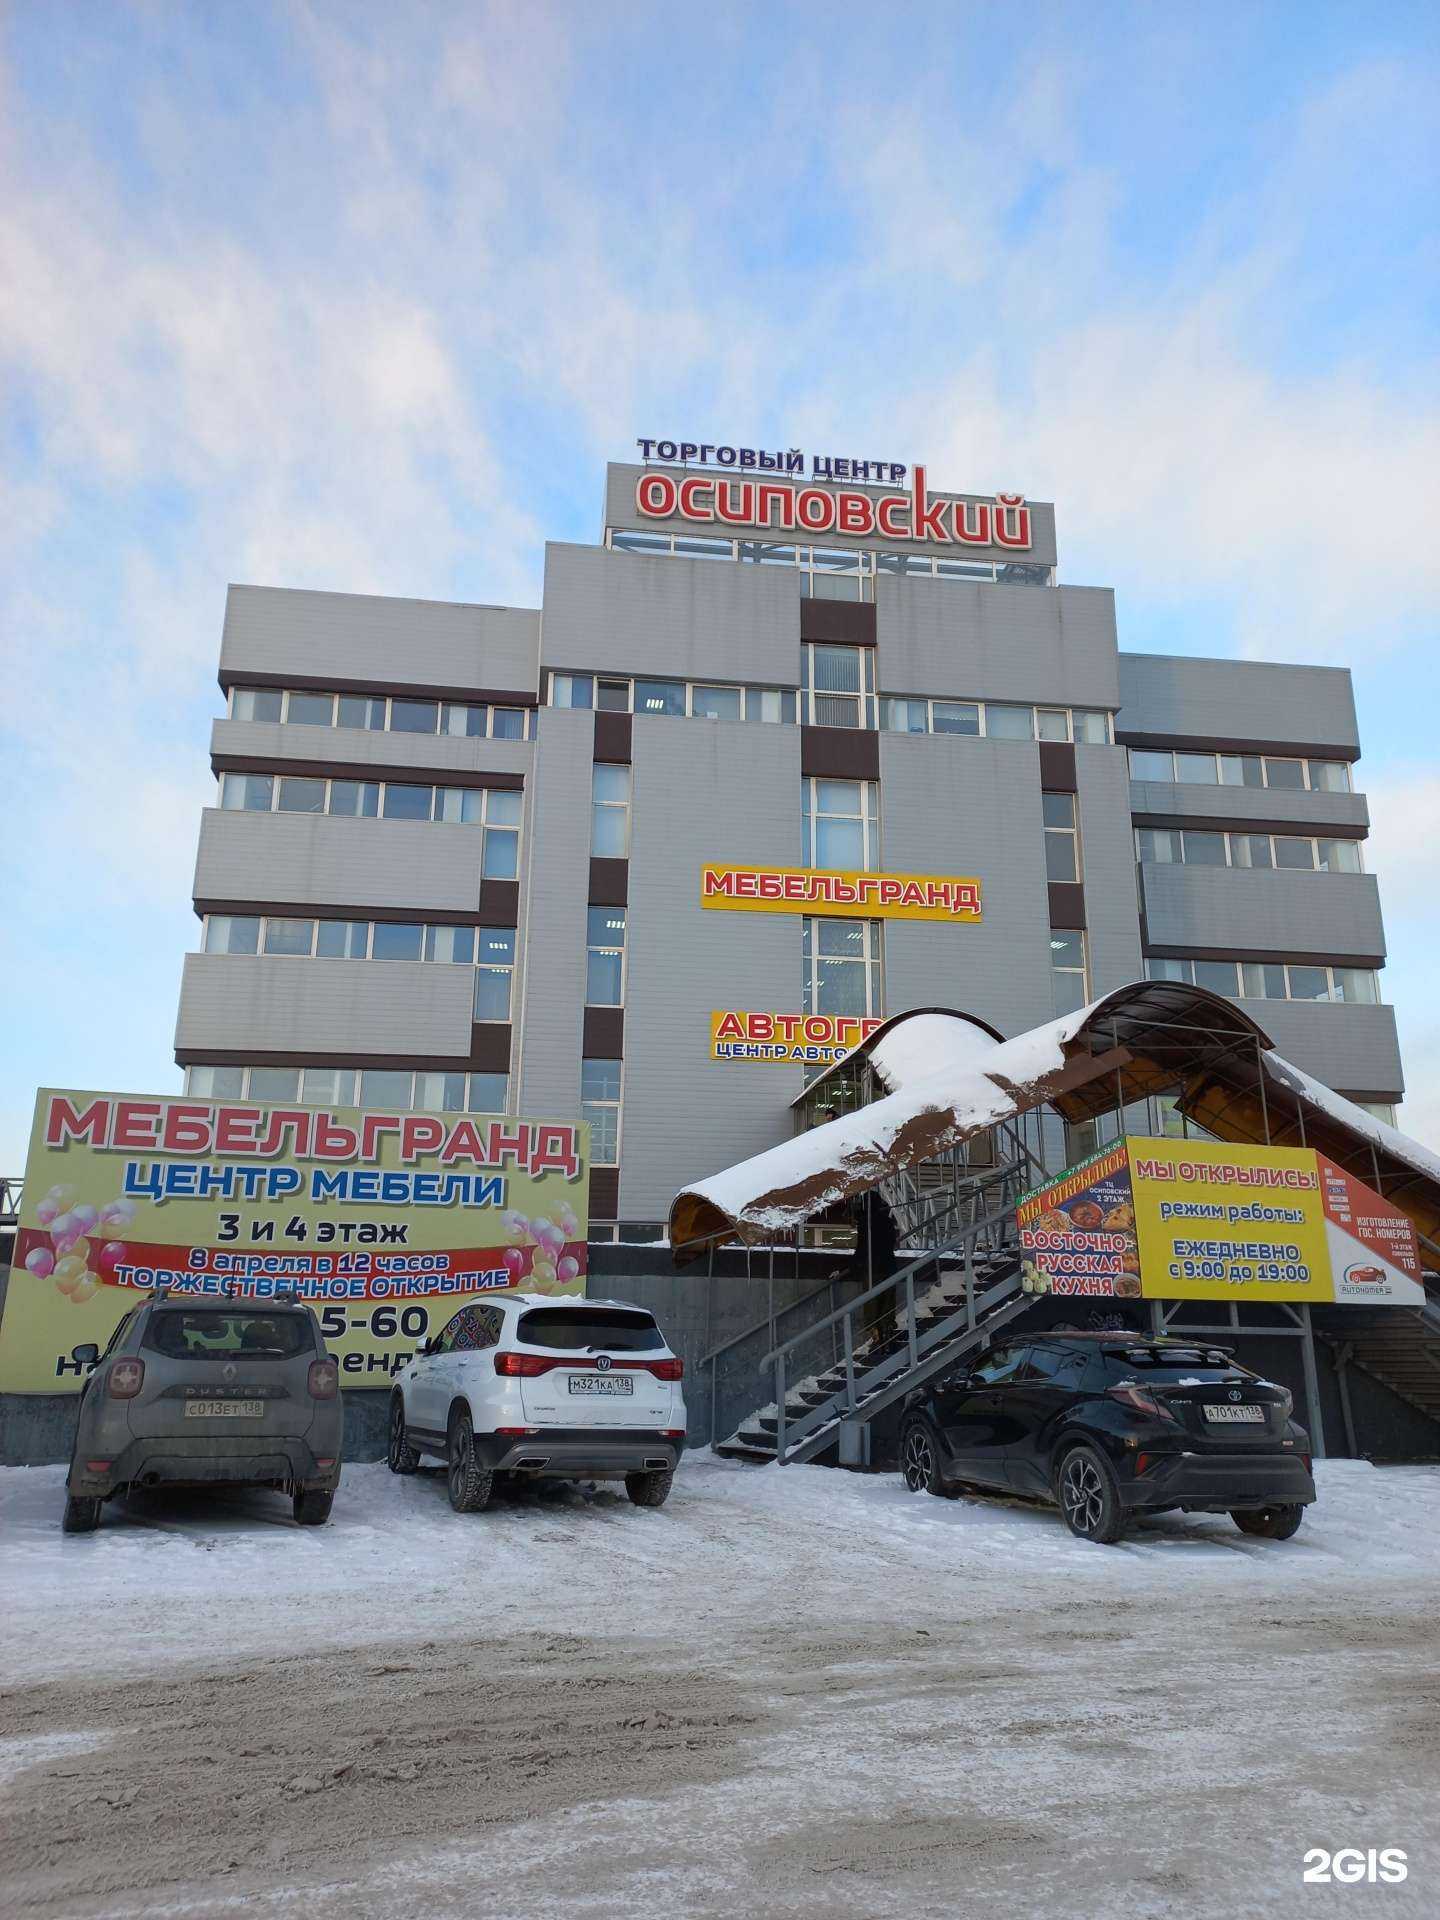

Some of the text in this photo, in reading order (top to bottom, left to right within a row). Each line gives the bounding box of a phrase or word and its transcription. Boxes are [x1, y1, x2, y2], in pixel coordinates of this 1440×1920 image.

[637, 438, 906, 481] ТОРГОВЫЙ ЦЕНТР
[704, 870, 981, 915] МЕБЕЛЬГРАНД
[715, 1013, 884, 1043] АВТОГР
[716, 1042, 852, 1061] ЦЕНТР АВТО
[45, 1096, 579, 1178] МЕБЕЛЬГРАНД
[124, 1161, 504, 1207] ЦЕНТР МЕБЕЛИ
[1136, 1160, 1318, 1189] МЫ ОТКРЫЛИСЬ!
[1019, 1149, 1127, 1225] МЫ ОТКРЫЛИСЬ!
[1020, 1178, 1059, 1204] ДОСТАВКА
[1160, 1201, 1304, 1223] режим работы:
[1356, 1216, 1410, 1229] ИЗГОТОВЛЕНИЕ
[218, 1214, 408, 1243] 3 и 4 этаж
[1358, 1228, 1411, 1240] ГОС. НОМЕРОВ
[1021, 1230, 1136, 1252] ВОСТОЧНО-
[1173, 1240, 1301, 1262] ЕЖЕДНЕВНО
[188, 1247, 449, 1276] 8 апреля в 12 часов
[1036, 1253, 1123, 1273] РУССКАЯ
[1169, 1260, 1309, 1282] с 9:00 до 19:00
[1402, 1258, 1415, 1269] 115
[114, 1264, 509, 1299] ТОРЖЕСТВЕННОЕ ОТКРЫТИЕ
[1050, 1276, 1114, 1296] КУХНЯ
[186, 1387, 268, 1395] DUSTER
